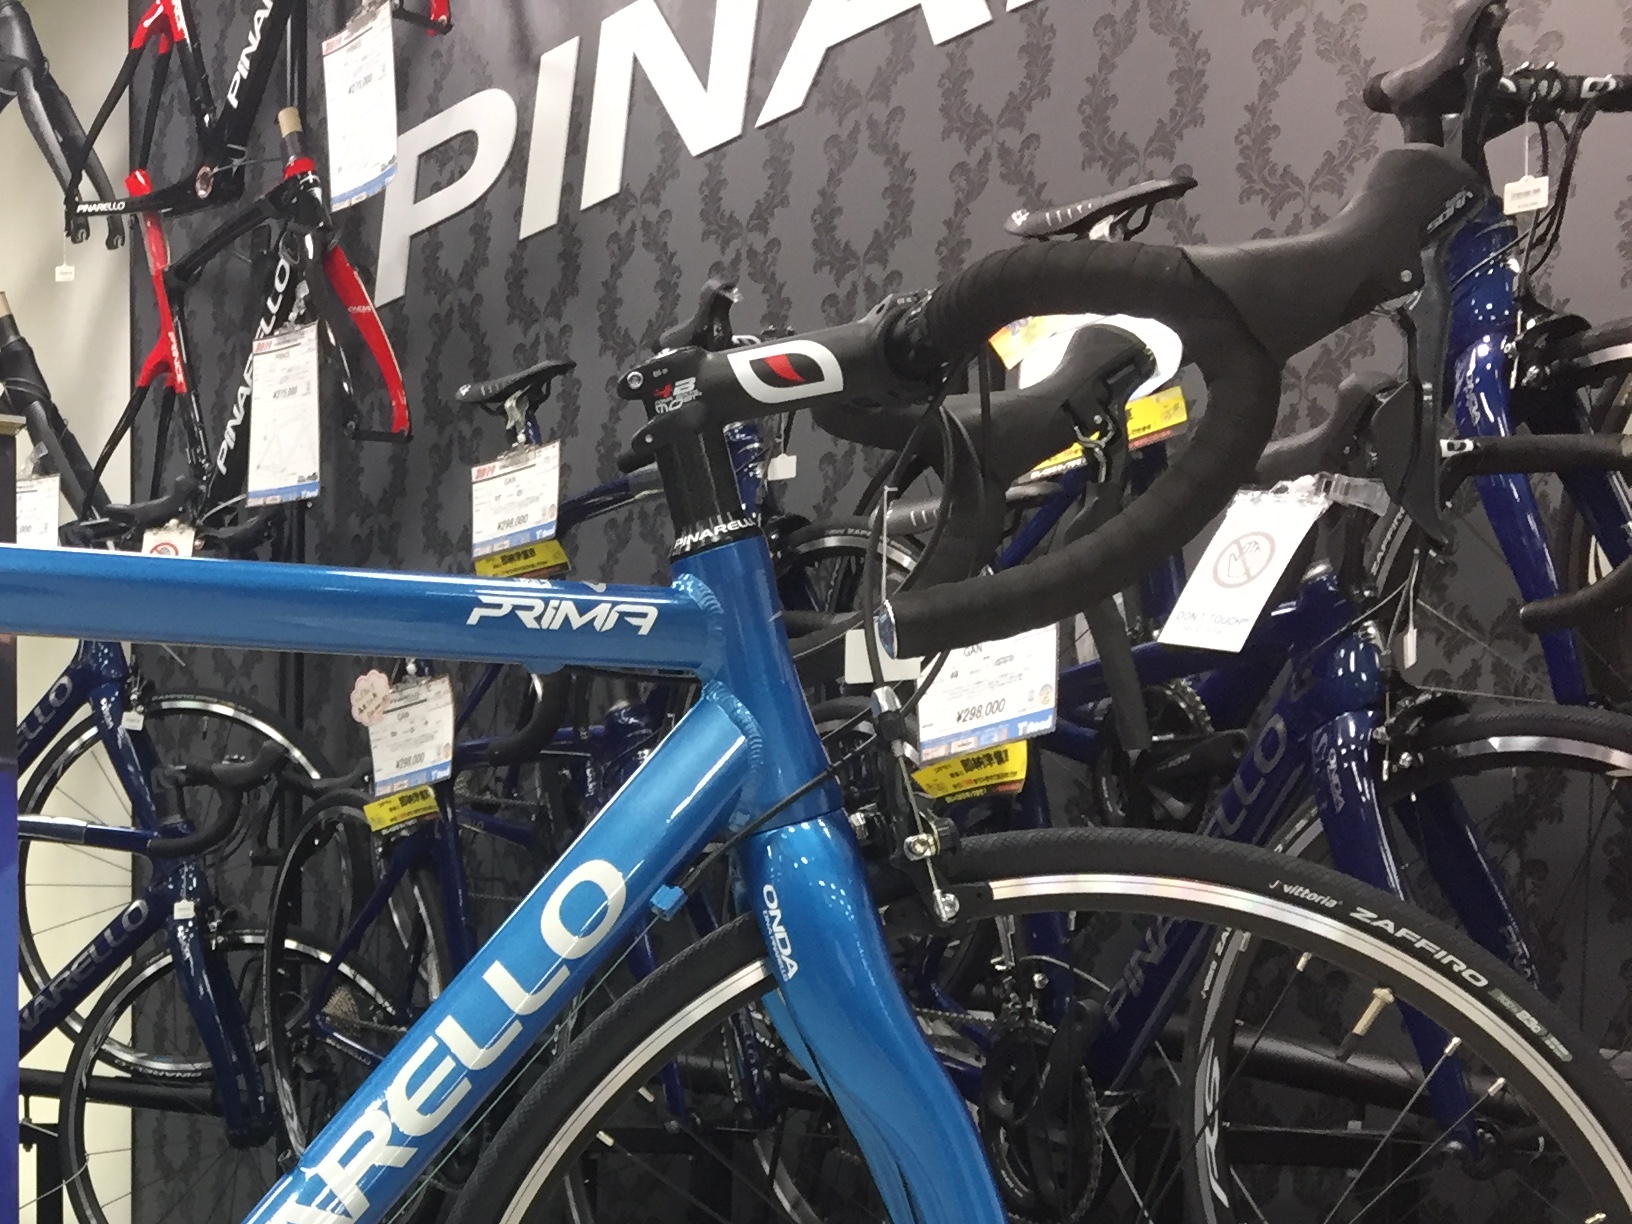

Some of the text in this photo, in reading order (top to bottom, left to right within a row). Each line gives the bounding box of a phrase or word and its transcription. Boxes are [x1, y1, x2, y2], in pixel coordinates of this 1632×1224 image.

[77, 202, 125, 213] PINARELLO
[674, 513, 762, 549] PINARELL
[963, 643, 983, 657] GAN
[956, 698, 1006, 724] ¥298,000
[763, 884, 798, 979] ONDA
[1280, 883, 1338, 908] vittoria
[1349, 906, 1489, 988] ZAFFIRO
